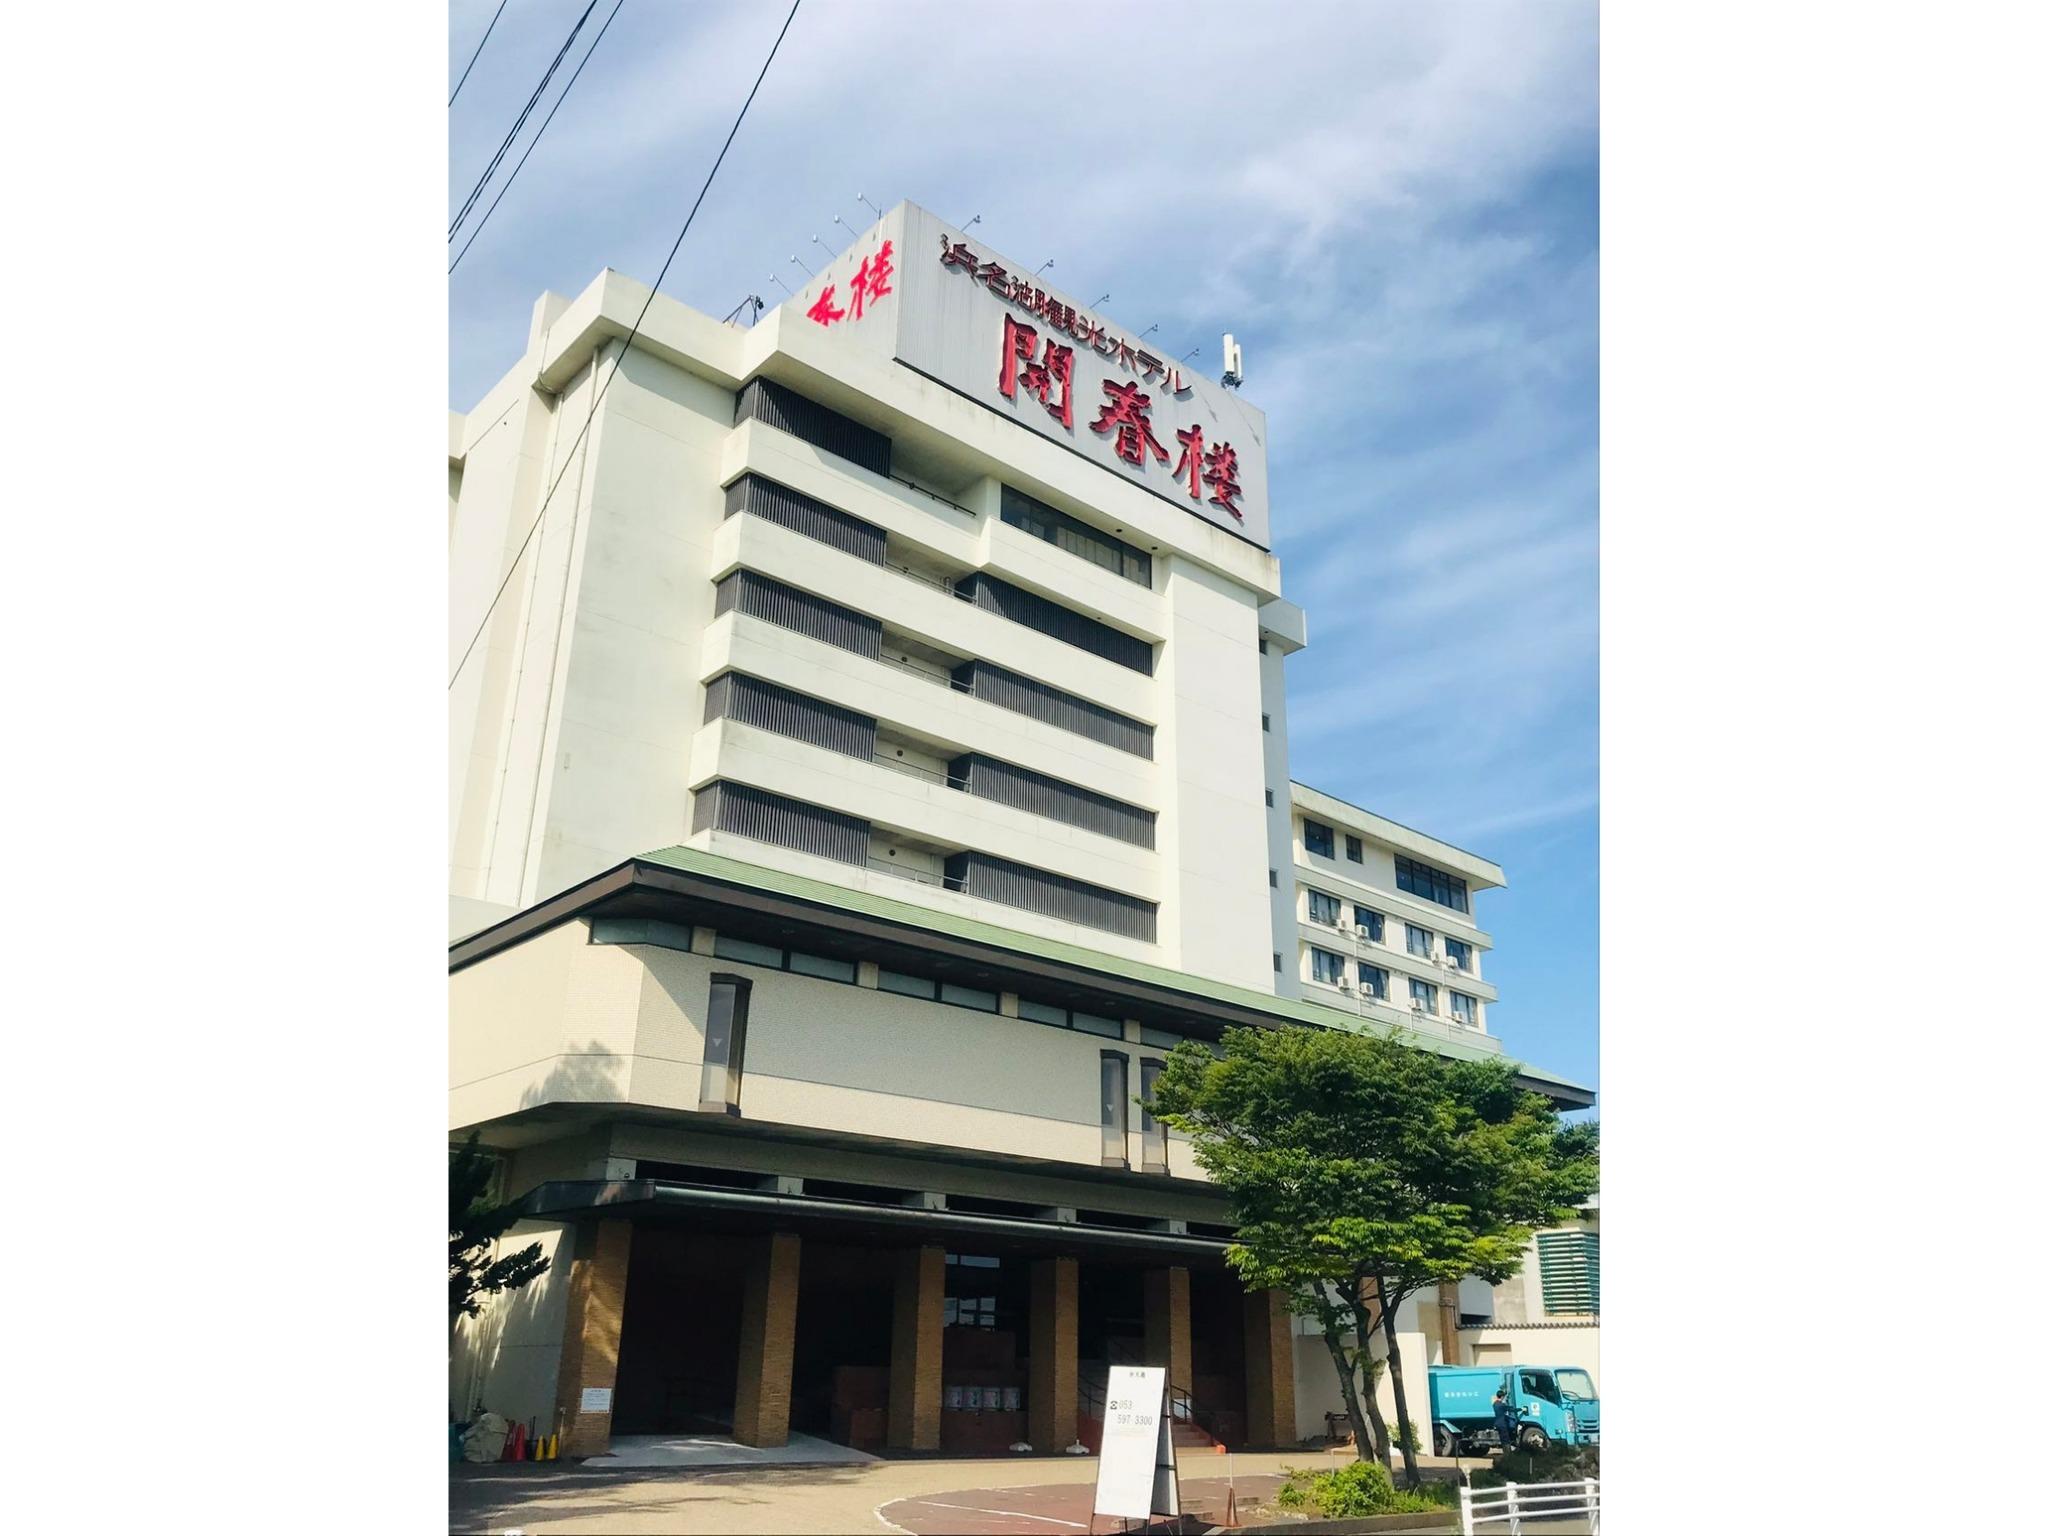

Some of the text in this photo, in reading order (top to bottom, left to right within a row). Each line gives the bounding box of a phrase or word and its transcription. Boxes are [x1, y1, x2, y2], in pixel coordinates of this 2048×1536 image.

[939, 232, 1193, 396] 浜名湖観光ホテル
[998, 311, 1244, 519] 開春楼
